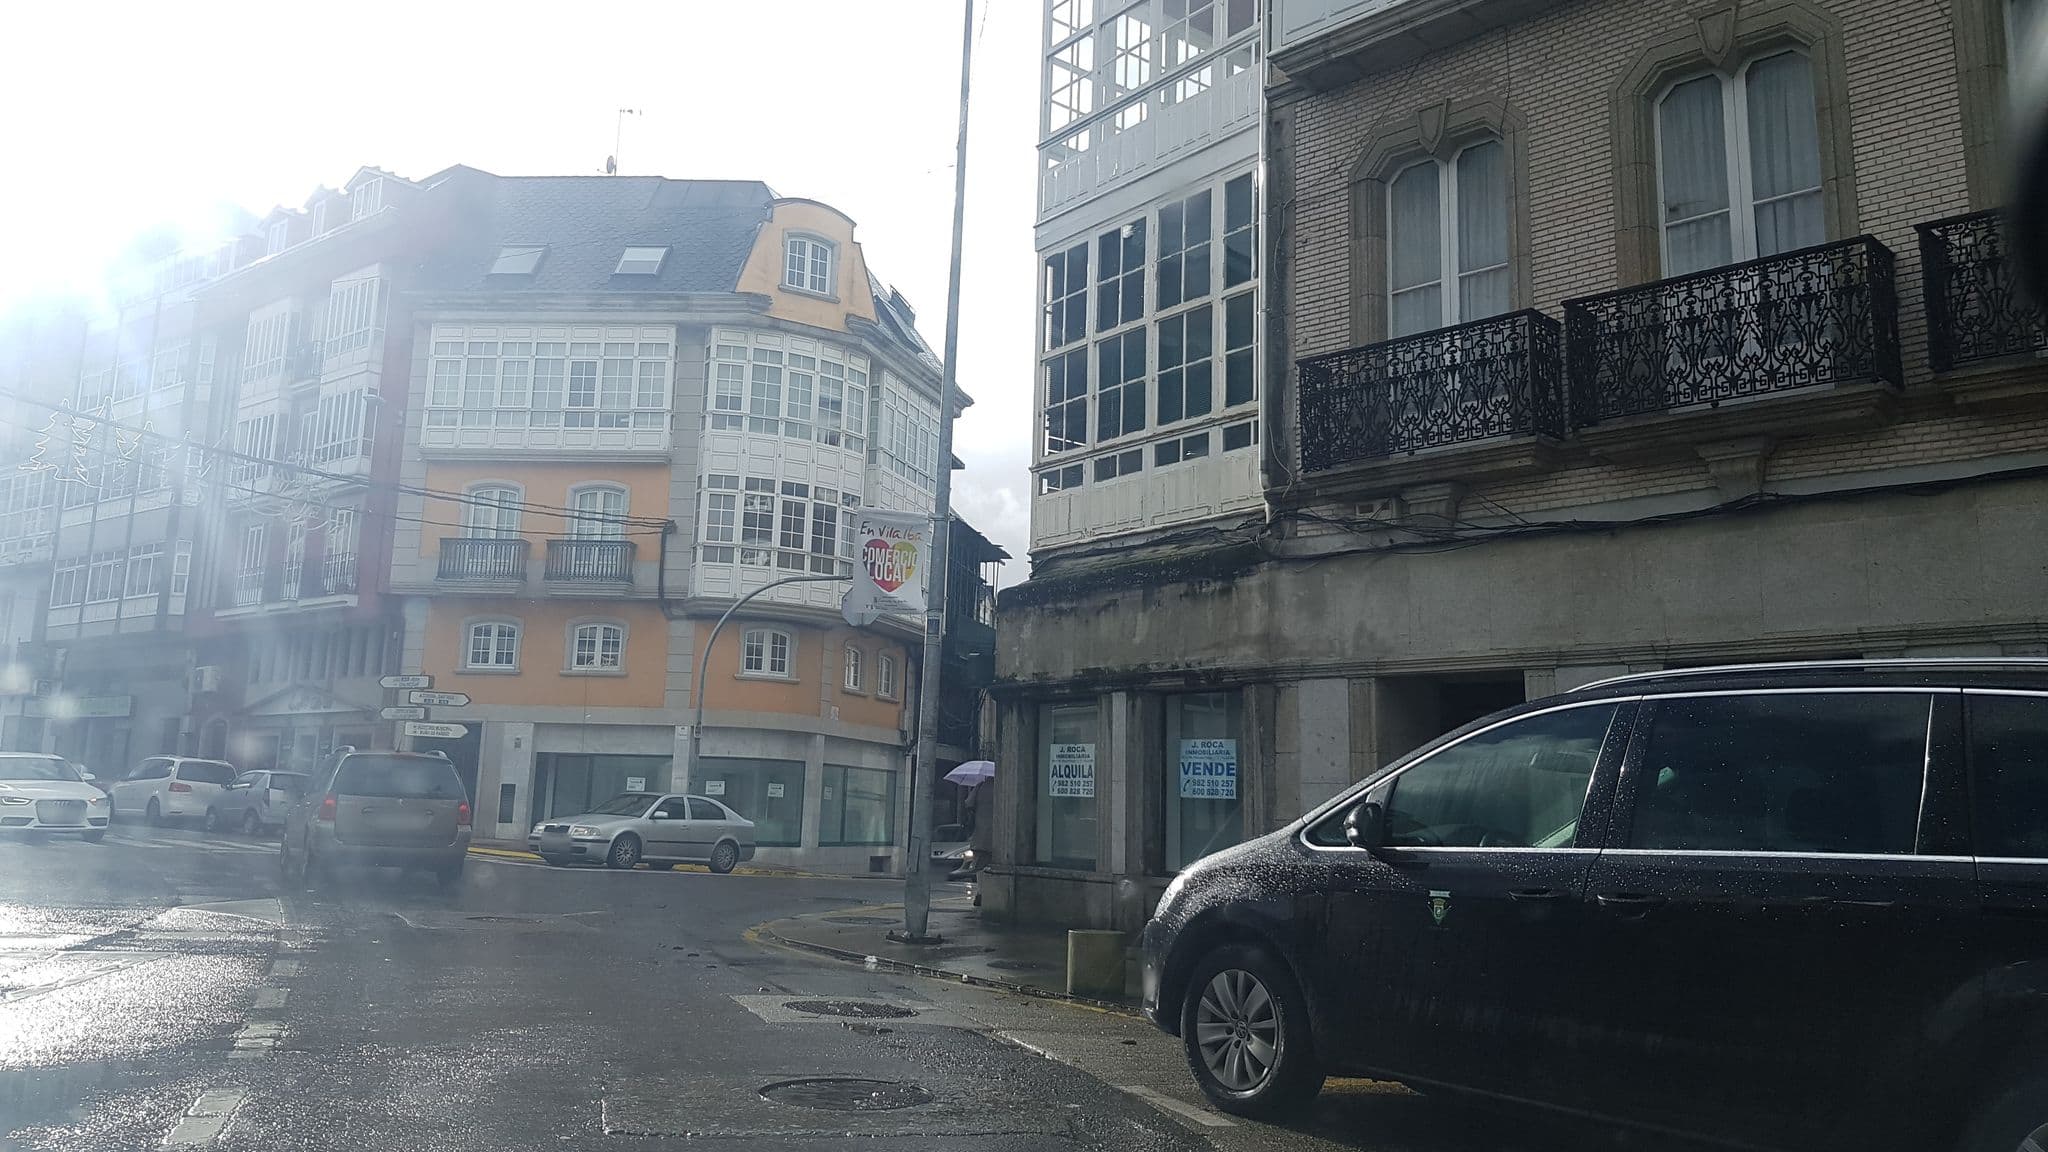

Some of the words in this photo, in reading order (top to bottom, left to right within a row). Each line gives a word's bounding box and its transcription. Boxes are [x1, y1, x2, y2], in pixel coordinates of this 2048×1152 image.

[860, 521, 875, 536] En
[879, 525, 922, 541] Vilalba
[862, 546, 919, 567] COMERCIO
[867, 562, 907, 582] LOCAL
[1051, 764, 1094, 779] ALQUILA
[1181, 762, 1236, 777] VENDE
[1221, 780, 1234, 788] 257
